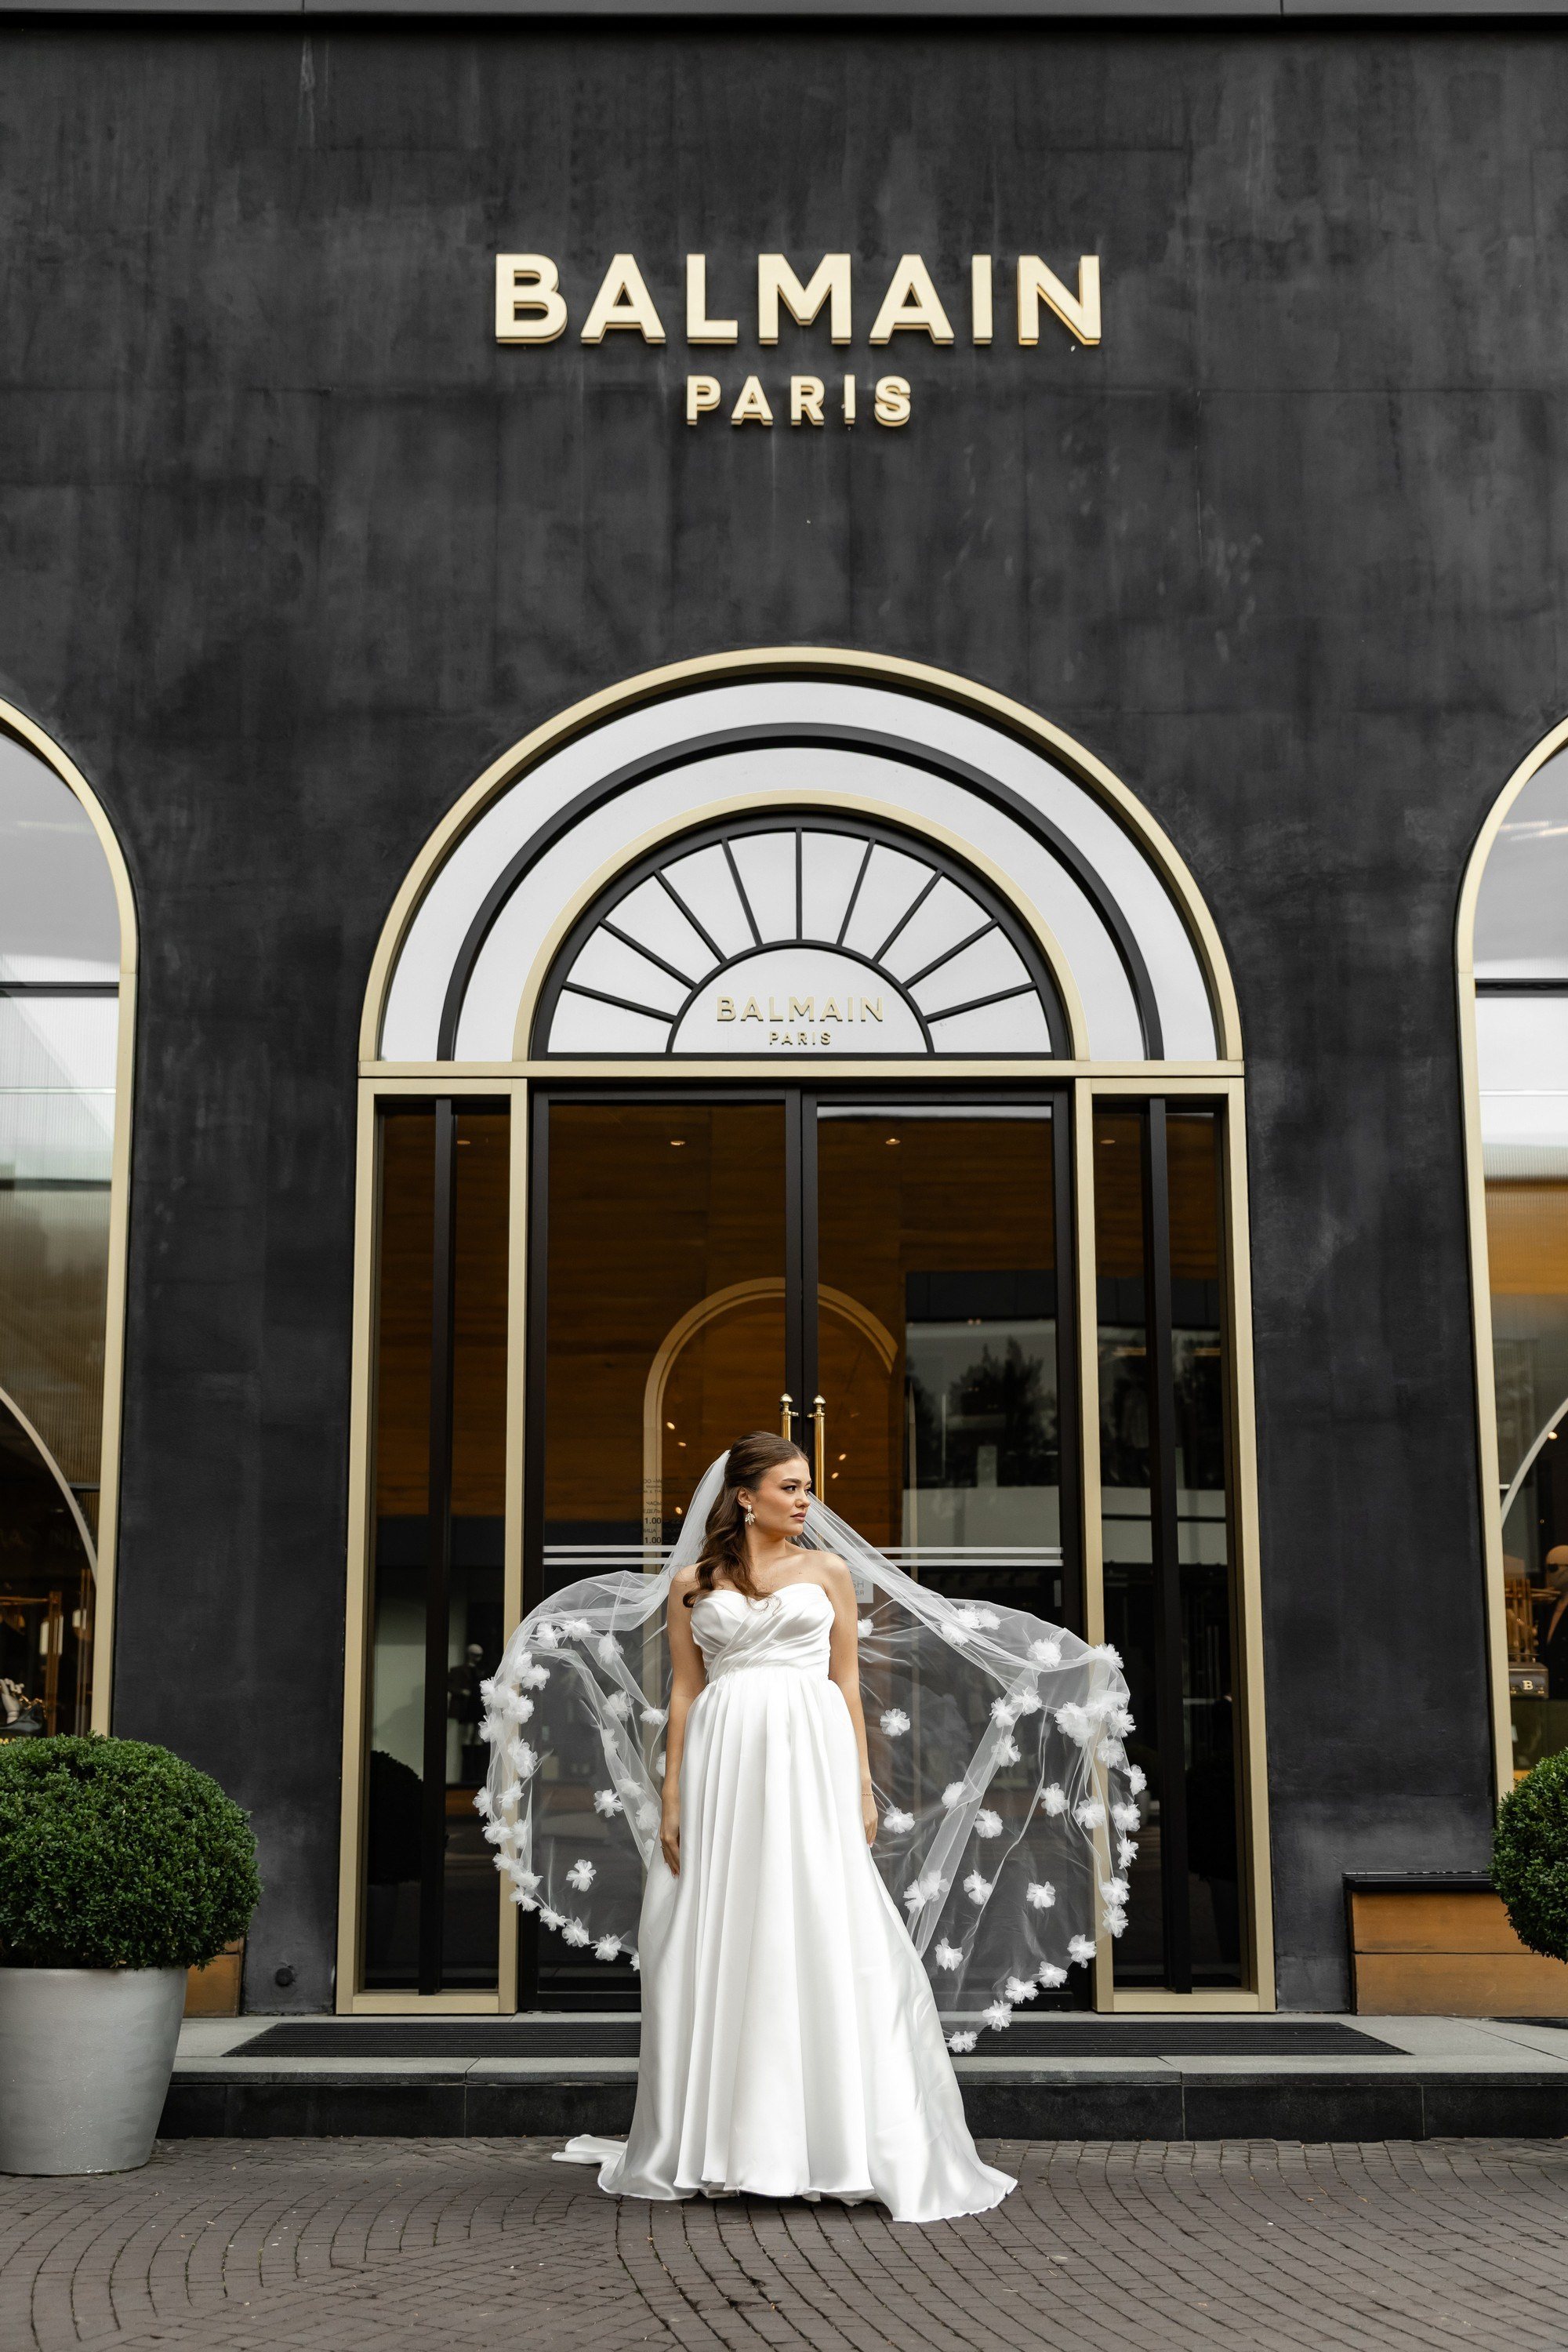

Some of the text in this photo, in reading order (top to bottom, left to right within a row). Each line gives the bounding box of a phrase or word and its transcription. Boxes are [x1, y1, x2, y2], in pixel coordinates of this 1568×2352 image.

[495, 254, 1101, 345] BALMAIN
[686, 374, 912, 426] PARIS
[717, 996, 884, 1022] BALMAIN
[769, 1031, 831, 1045] PARIS
[1522, 1680, 1534, 1690] B
